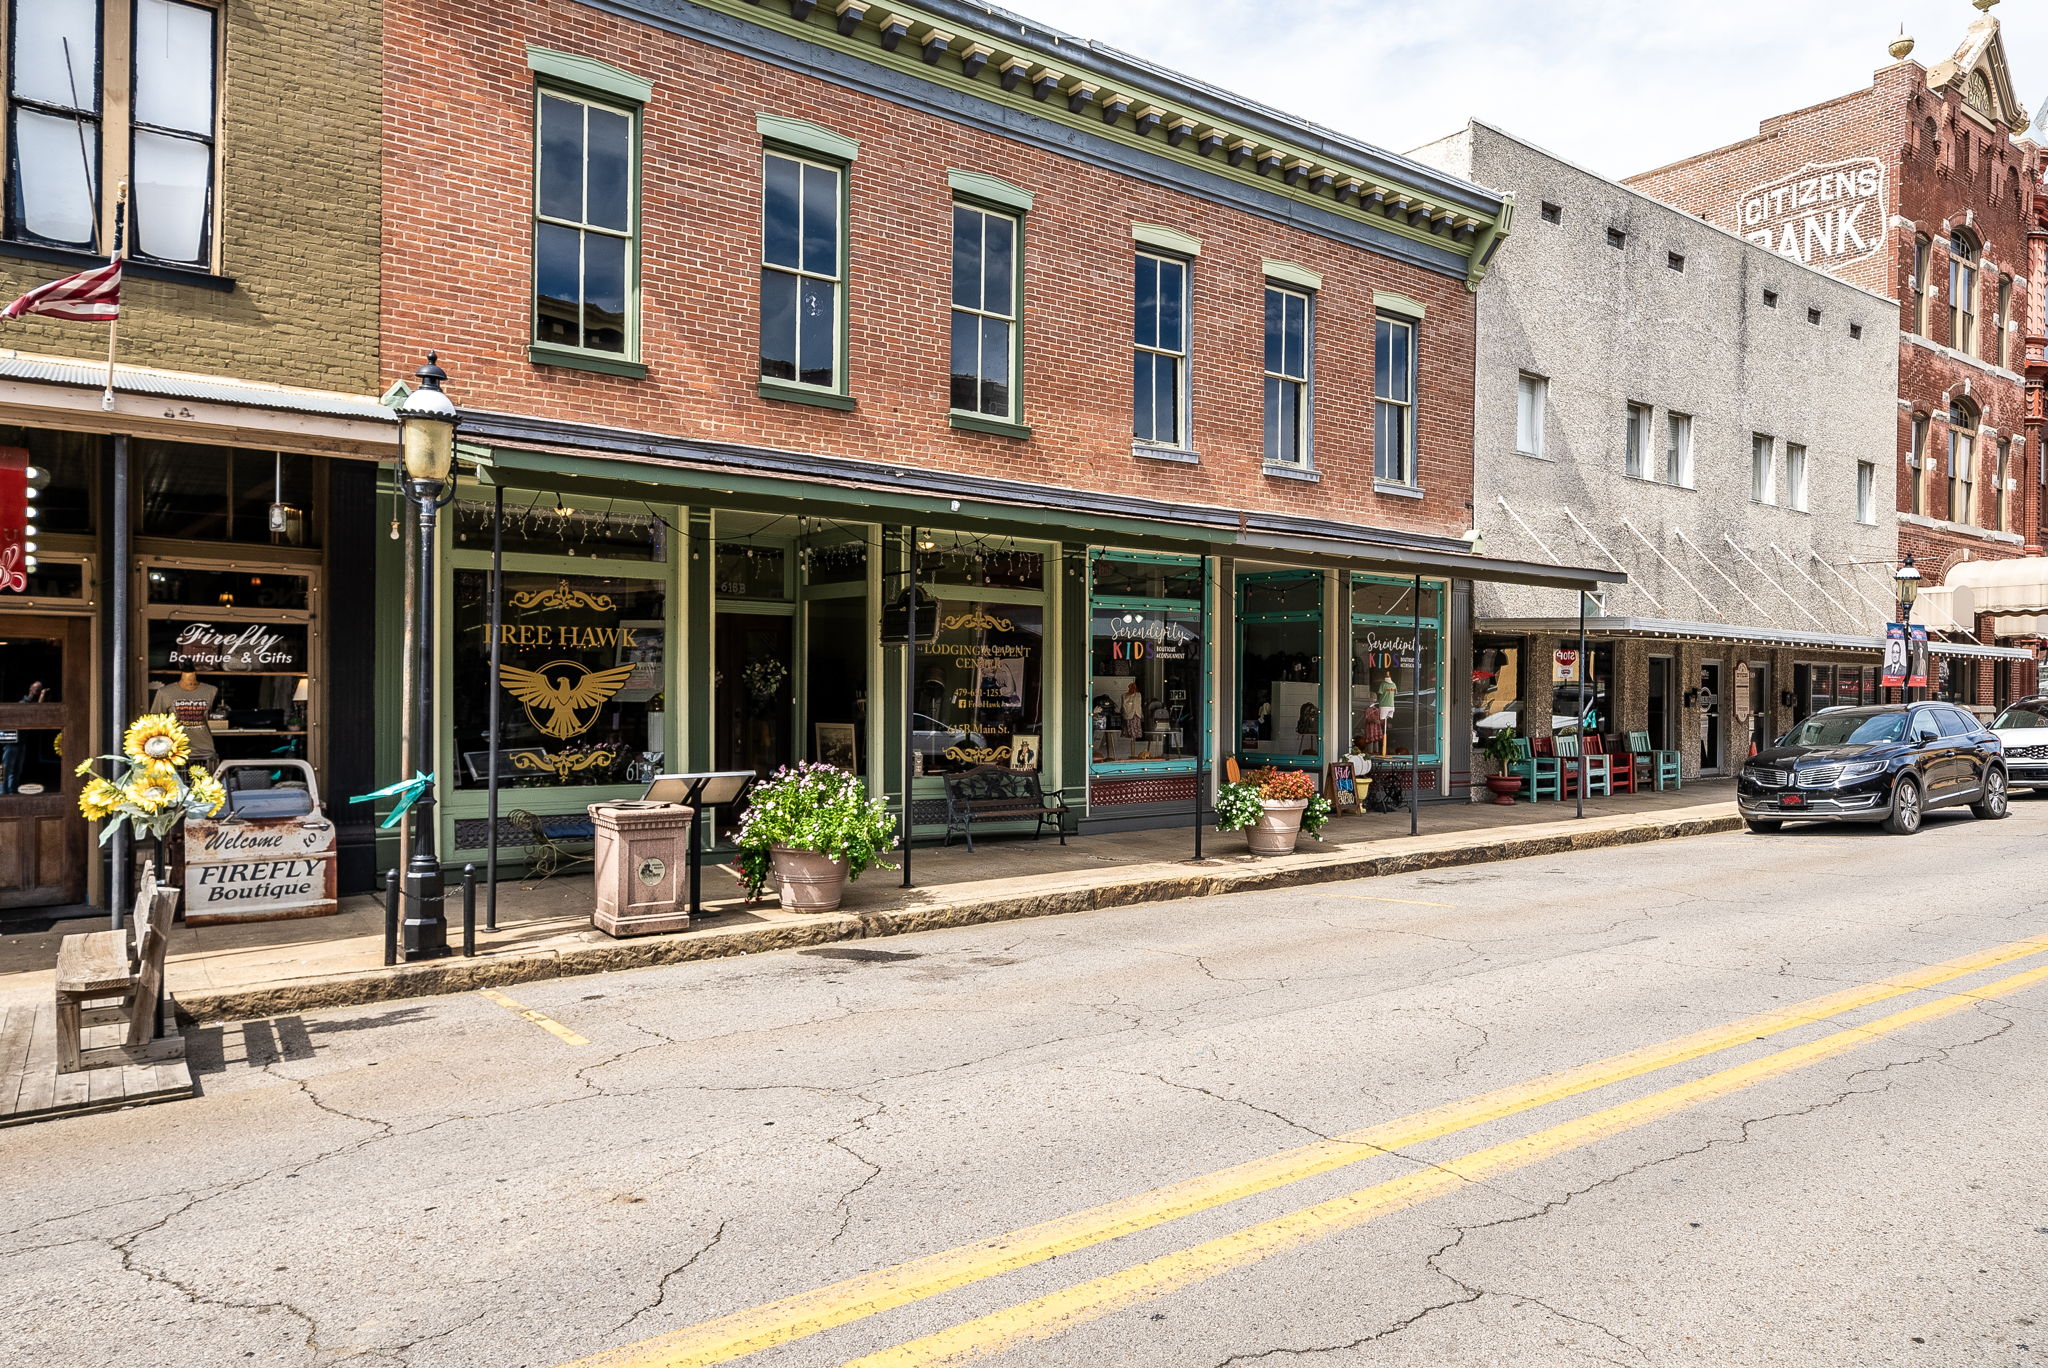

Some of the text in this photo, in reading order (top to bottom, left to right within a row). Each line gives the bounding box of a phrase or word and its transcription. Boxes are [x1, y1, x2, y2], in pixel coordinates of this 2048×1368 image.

[1745, 168, 1877, 225] CITIZENS
[176, 623, 284, 655] Firefly
[558, 626, 638, 648] HAWK
[1110, 617, 1186, 646] Serendipity
[169, 651, 292, 665] Boutique & Gifts
[925, 644, 980, 655] LODGING
[1113, 641, 1155, 660] KIDS
[1368, 652, 1400, 669] KIDS
[973, 724, 996, 734] Main
[998, 724, 1010, 734] St.
[204, 831, 317, 850] Welcome to
[199, 859, 322, 885] FIREFLY
[208, 882, 311, 902] Boutique
